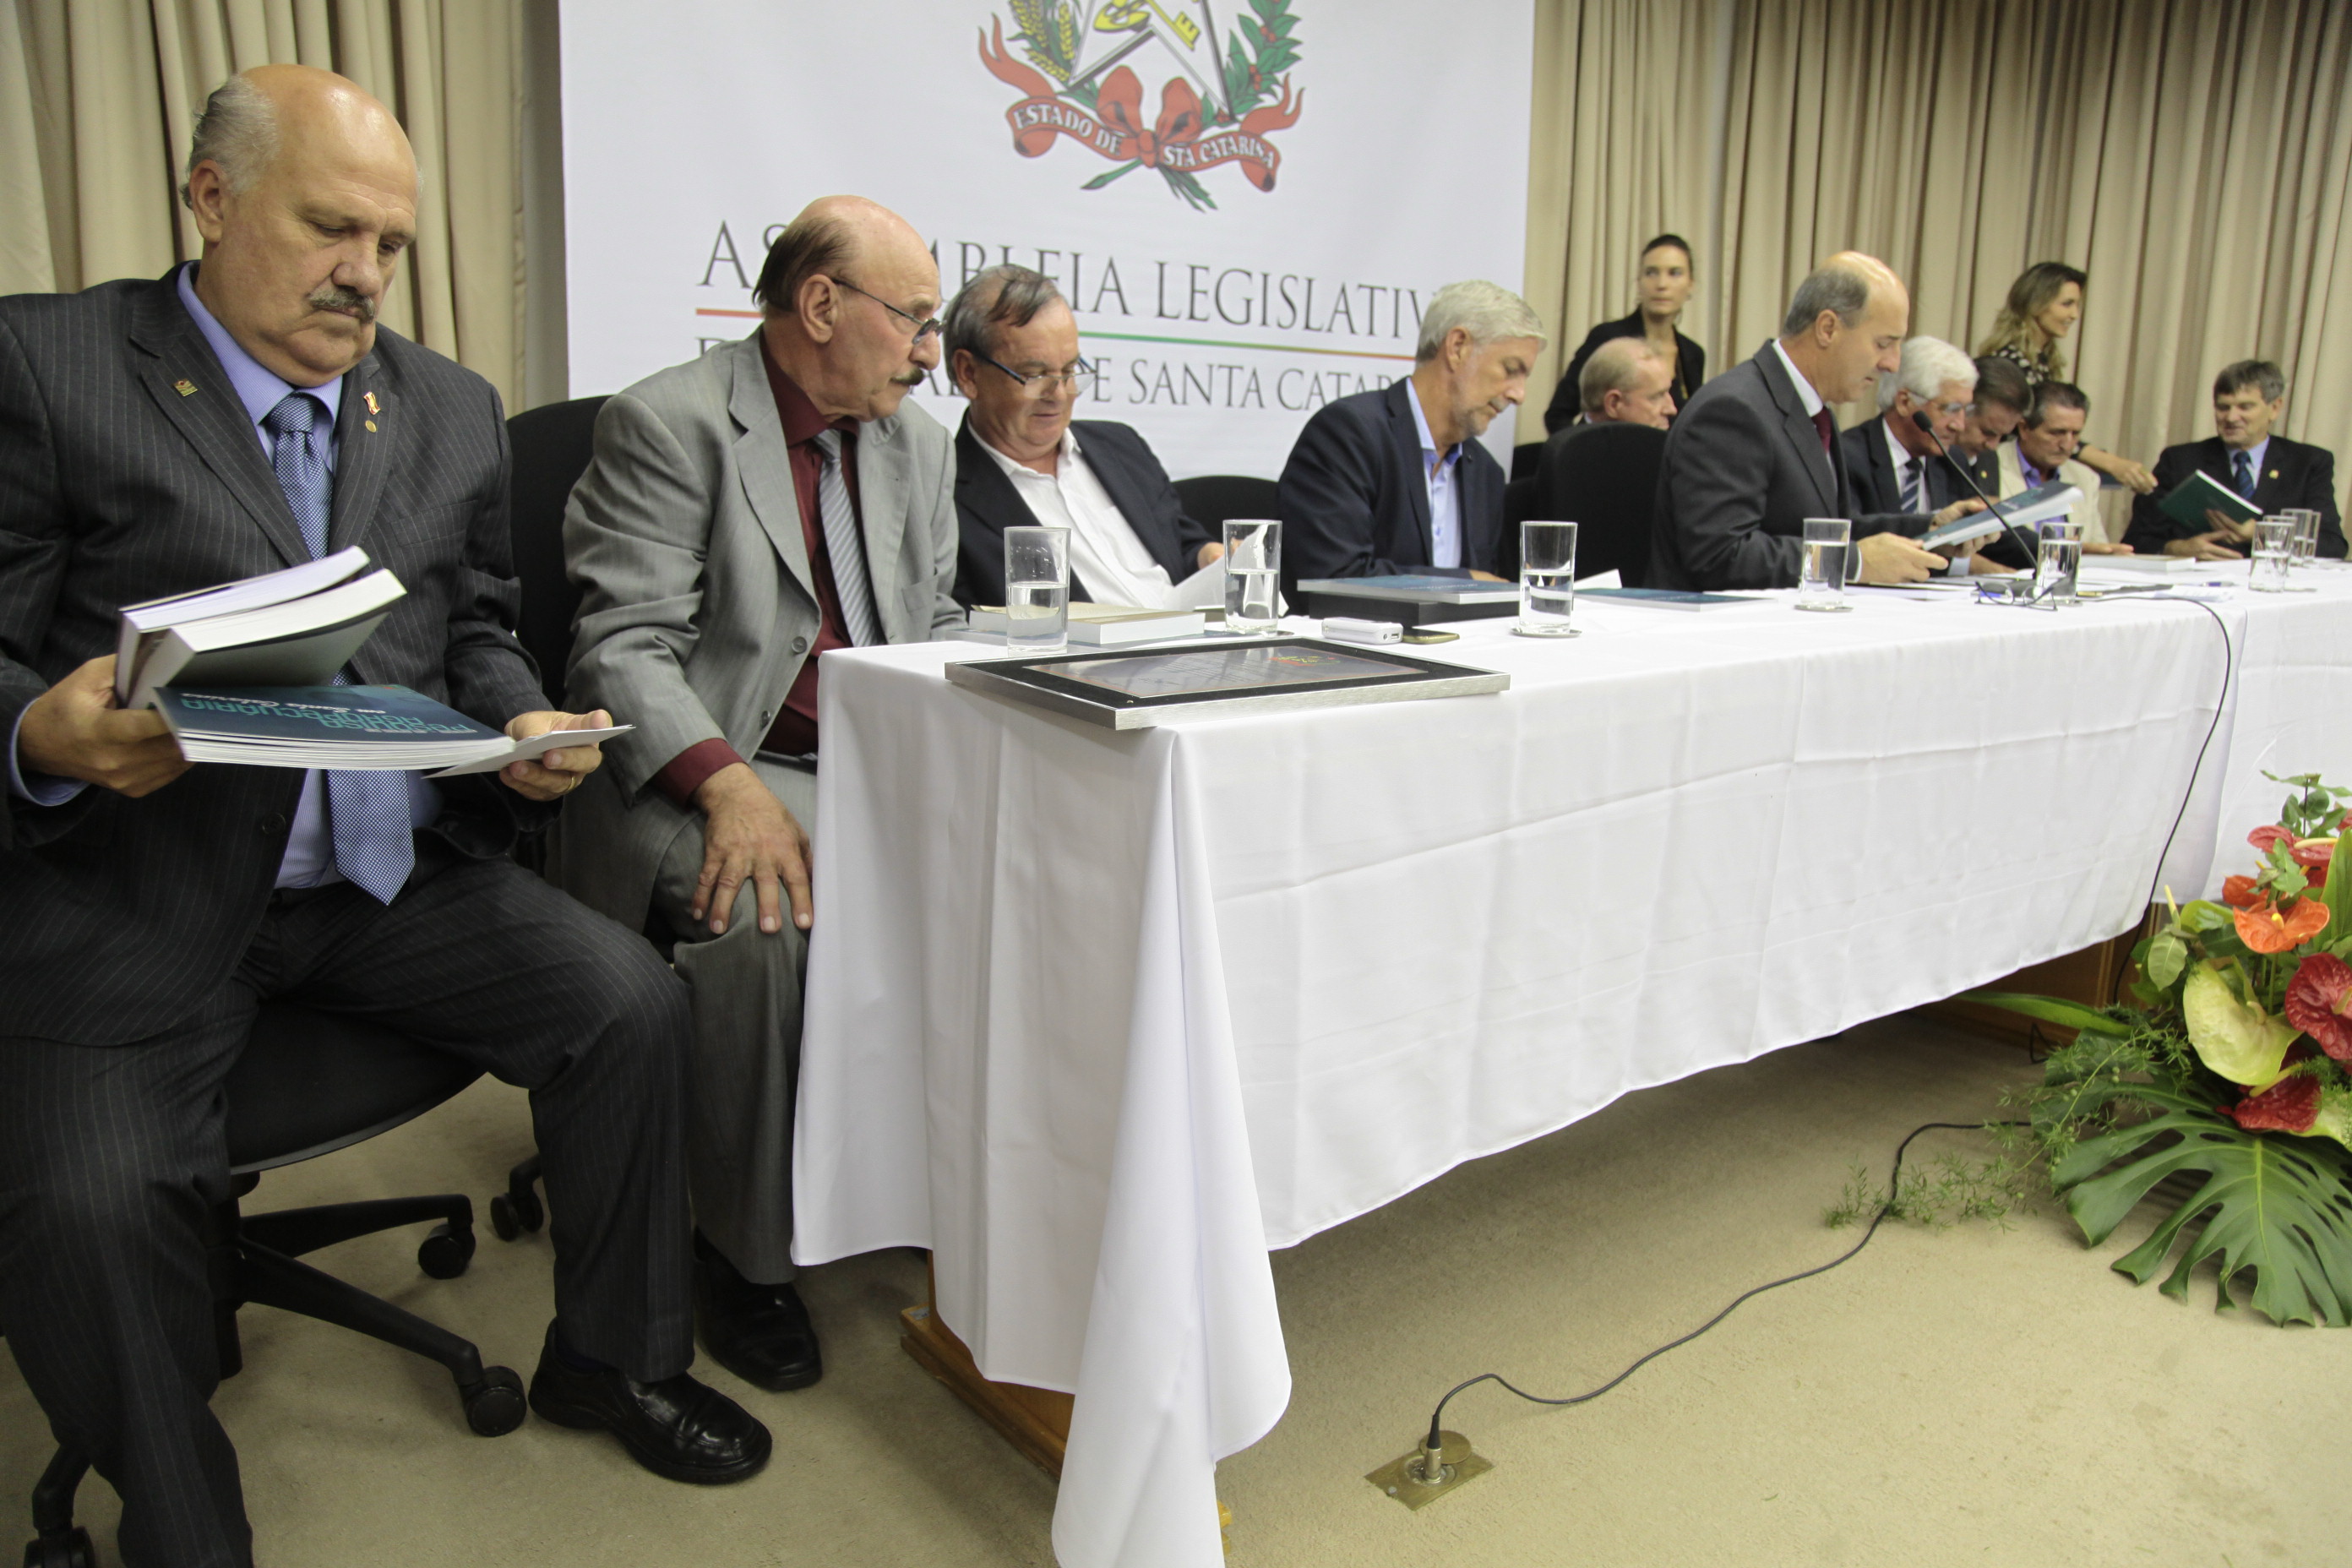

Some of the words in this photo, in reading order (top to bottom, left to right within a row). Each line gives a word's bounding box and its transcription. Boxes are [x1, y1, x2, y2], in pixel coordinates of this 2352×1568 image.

[1013, 104, 1093, 138] ESTADO
[1094, 128, 1123, 156] DE
[1200, 134, 1274, 169] CATARINA
[1129, 358, 1266, 409] SANTA
